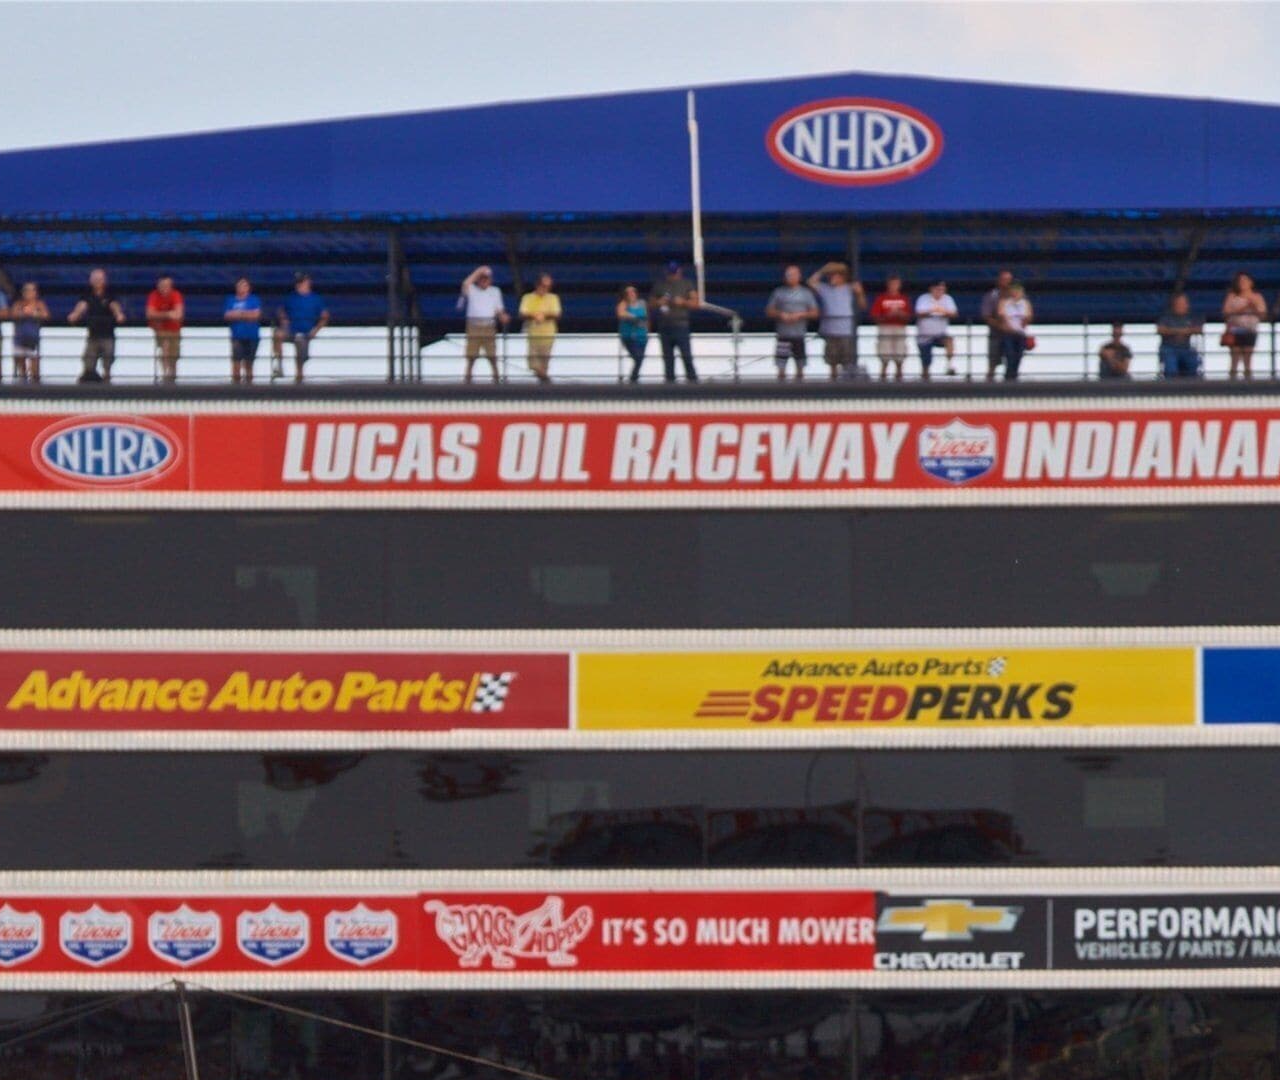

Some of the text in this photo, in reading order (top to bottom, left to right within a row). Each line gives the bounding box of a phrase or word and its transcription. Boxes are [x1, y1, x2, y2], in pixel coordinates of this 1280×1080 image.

[793, 111, 917, 169] NHRA
[56, 422, 162, 476] NHRA
[282, 421, 910, 483] LUCAS OIL RACEWAY
[763, 657, 984, 678] Advance Auto Parts
[7, 670, 464, 712] Advance Auto Parts
[602, 918, 875, 945] IT'S SO MUCH MOWER
[873, 952, 1023, 969] CHEVROLET
[1075, 941, 1164, 960] VEHICLES
[1178, 940, 1234, 959] PARTS
